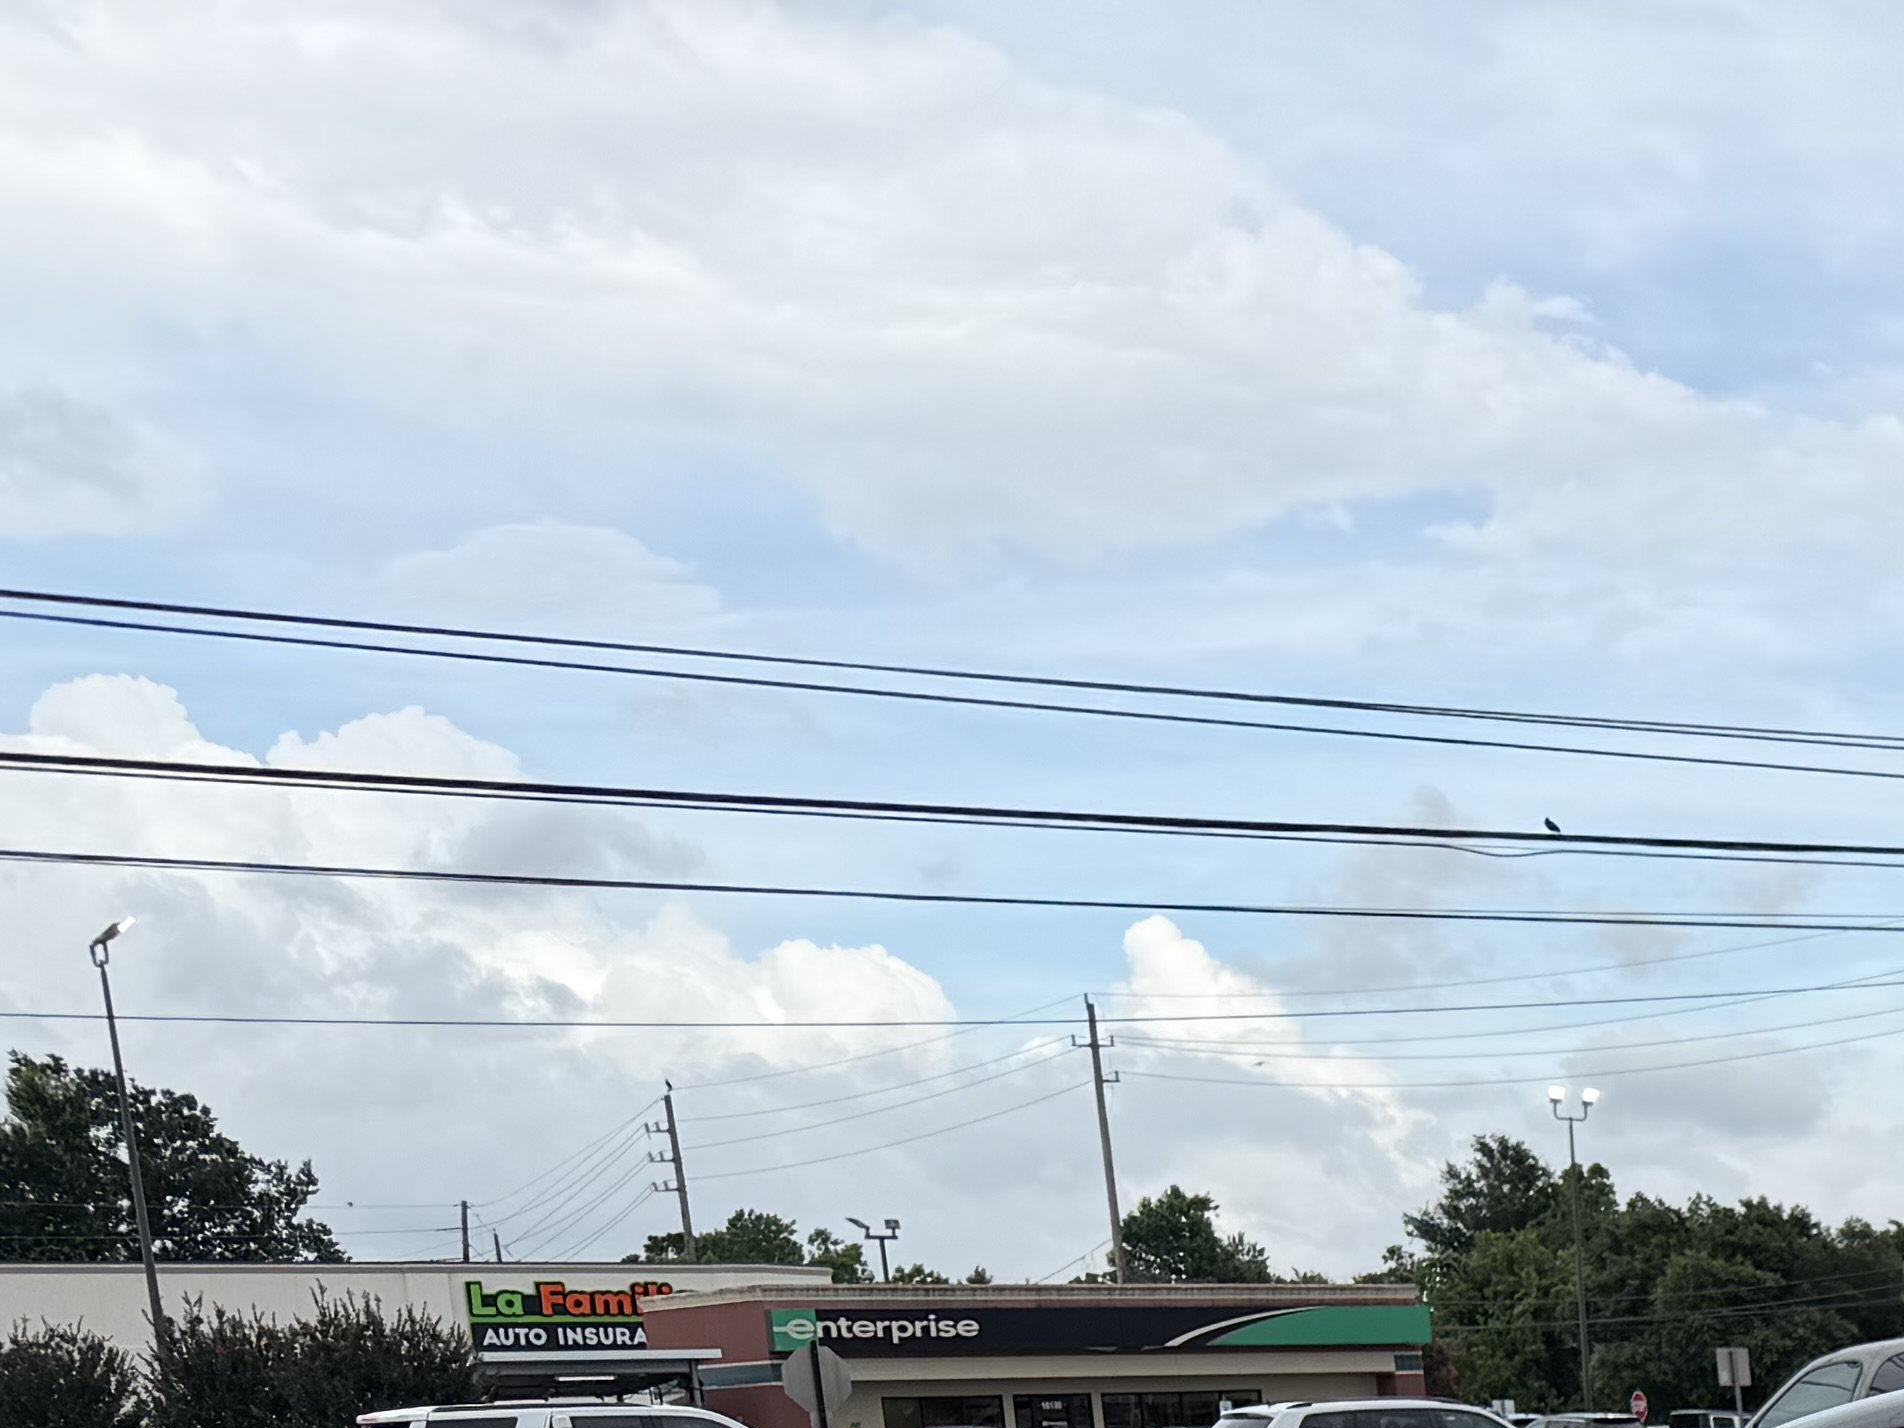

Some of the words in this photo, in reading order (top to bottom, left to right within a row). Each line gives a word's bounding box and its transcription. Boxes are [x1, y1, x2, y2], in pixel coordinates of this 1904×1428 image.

[468, 1281, 525, 1316] La
[483, 1327, 548, 1346] AUTO
[785, 1314, 981, 1345] enterprise
